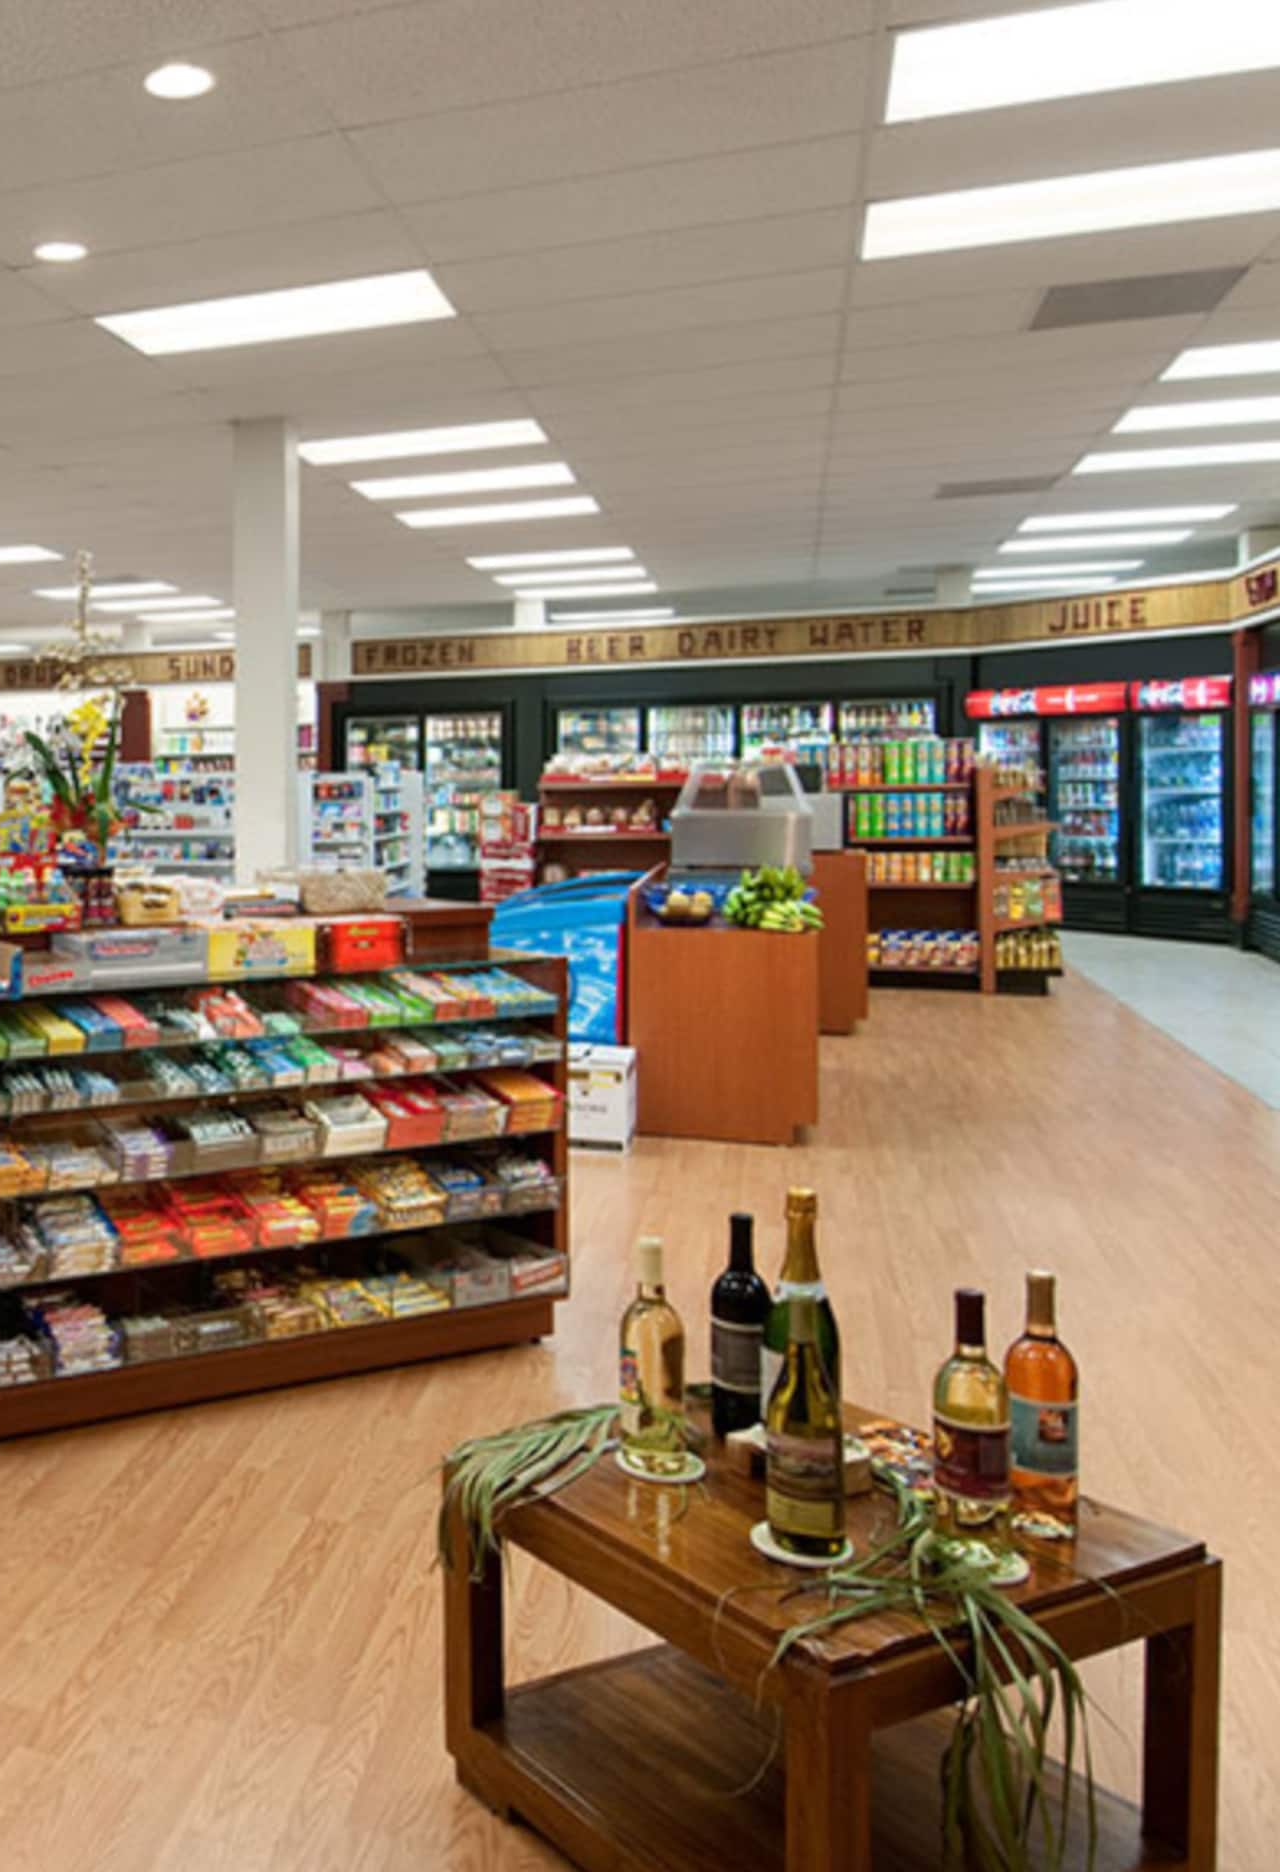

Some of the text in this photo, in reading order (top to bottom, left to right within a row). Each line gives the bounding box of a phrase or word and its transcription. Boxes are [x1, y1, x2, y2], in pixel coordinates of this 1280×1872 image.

[1049, 596, 1147, 633] JUICE
[365, 618, 927, 668] FROZEN BEER DAIRY WATER
